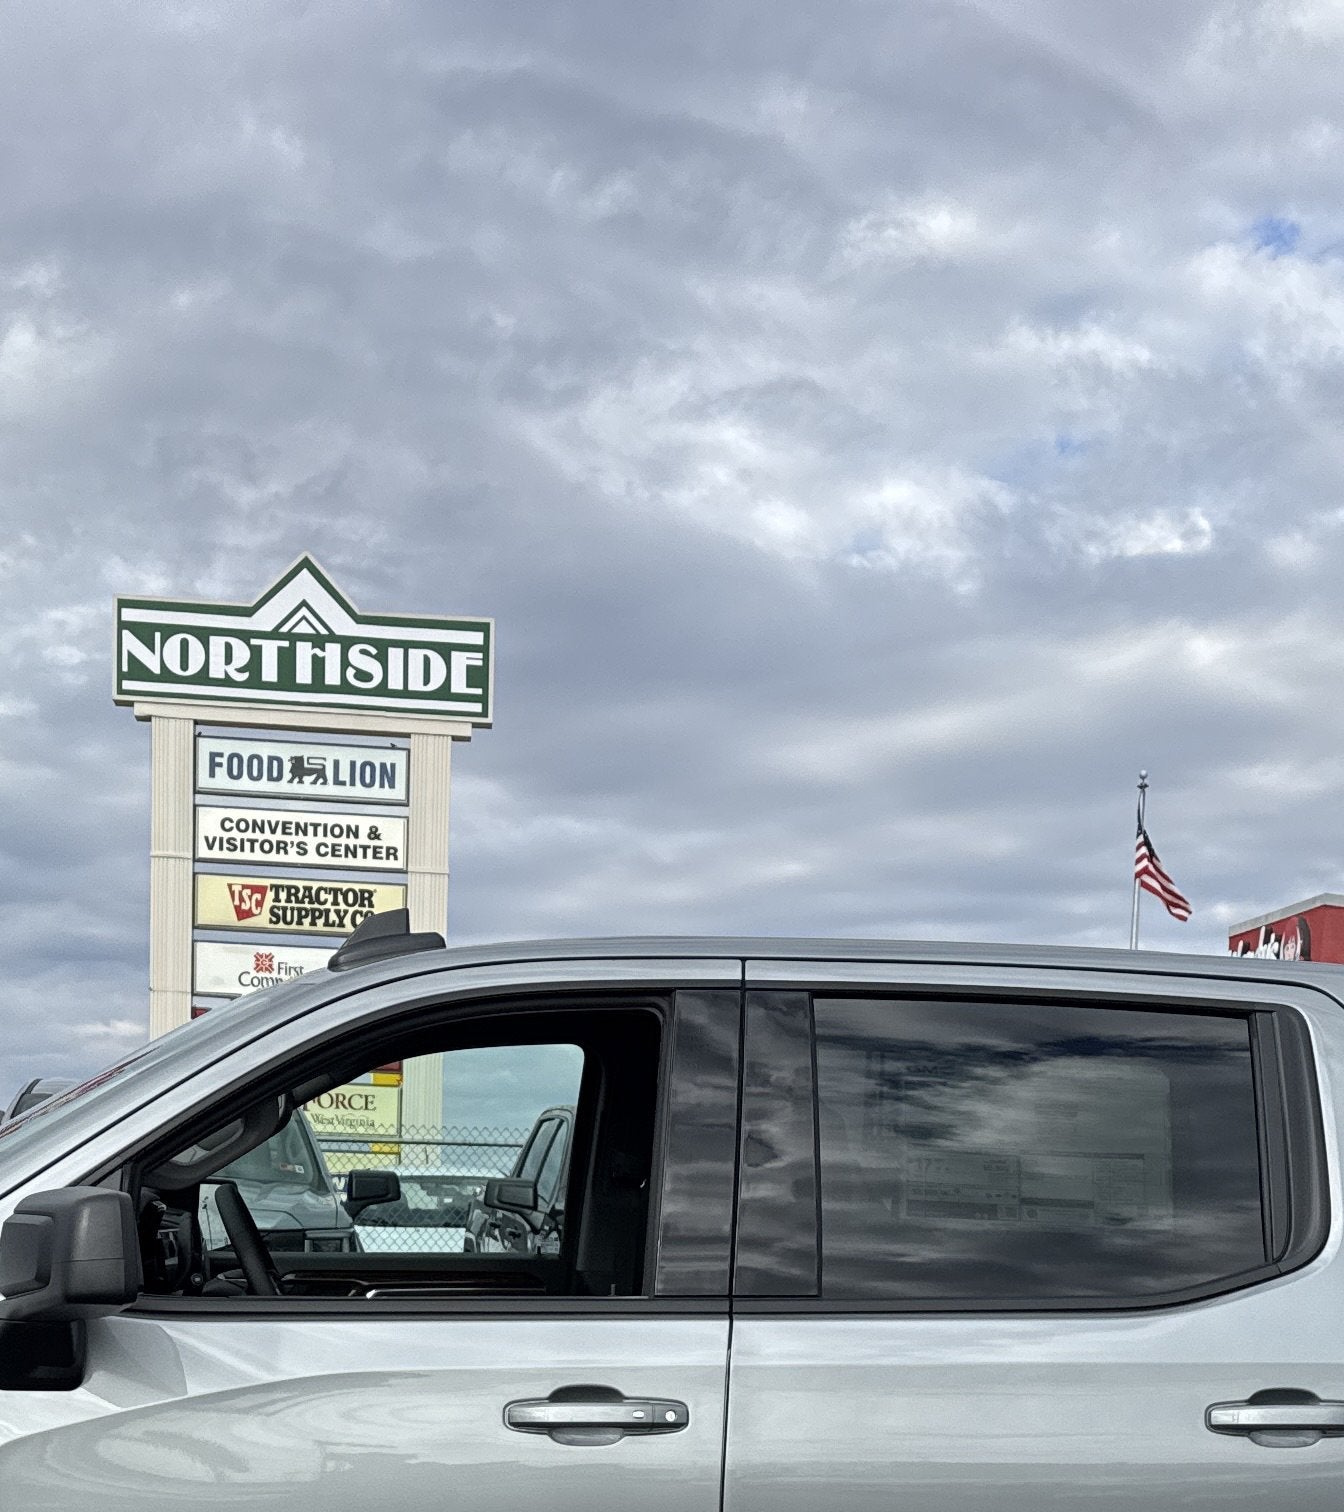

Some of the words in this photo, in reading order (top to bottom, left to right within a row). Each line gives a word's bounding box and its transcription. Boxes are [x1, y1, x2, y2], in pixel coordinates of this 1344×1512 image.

[121, 629, 483, 695] NORTHSIDE
[208, 751, 283, 782] FOOD
[333, 758, 396, 789] LION
[220, 816, 360, 840] CONVENTION
[367, 825, 382, 841] &
[204, 836, 308, 857] VISITOR'S
[315, 842, 399, 861] CENTER
[232, 884, 262, 915] TSC
[269, 883, 375, 909] TRACTOR
[269, 904, 349, 928] SUPPLY
